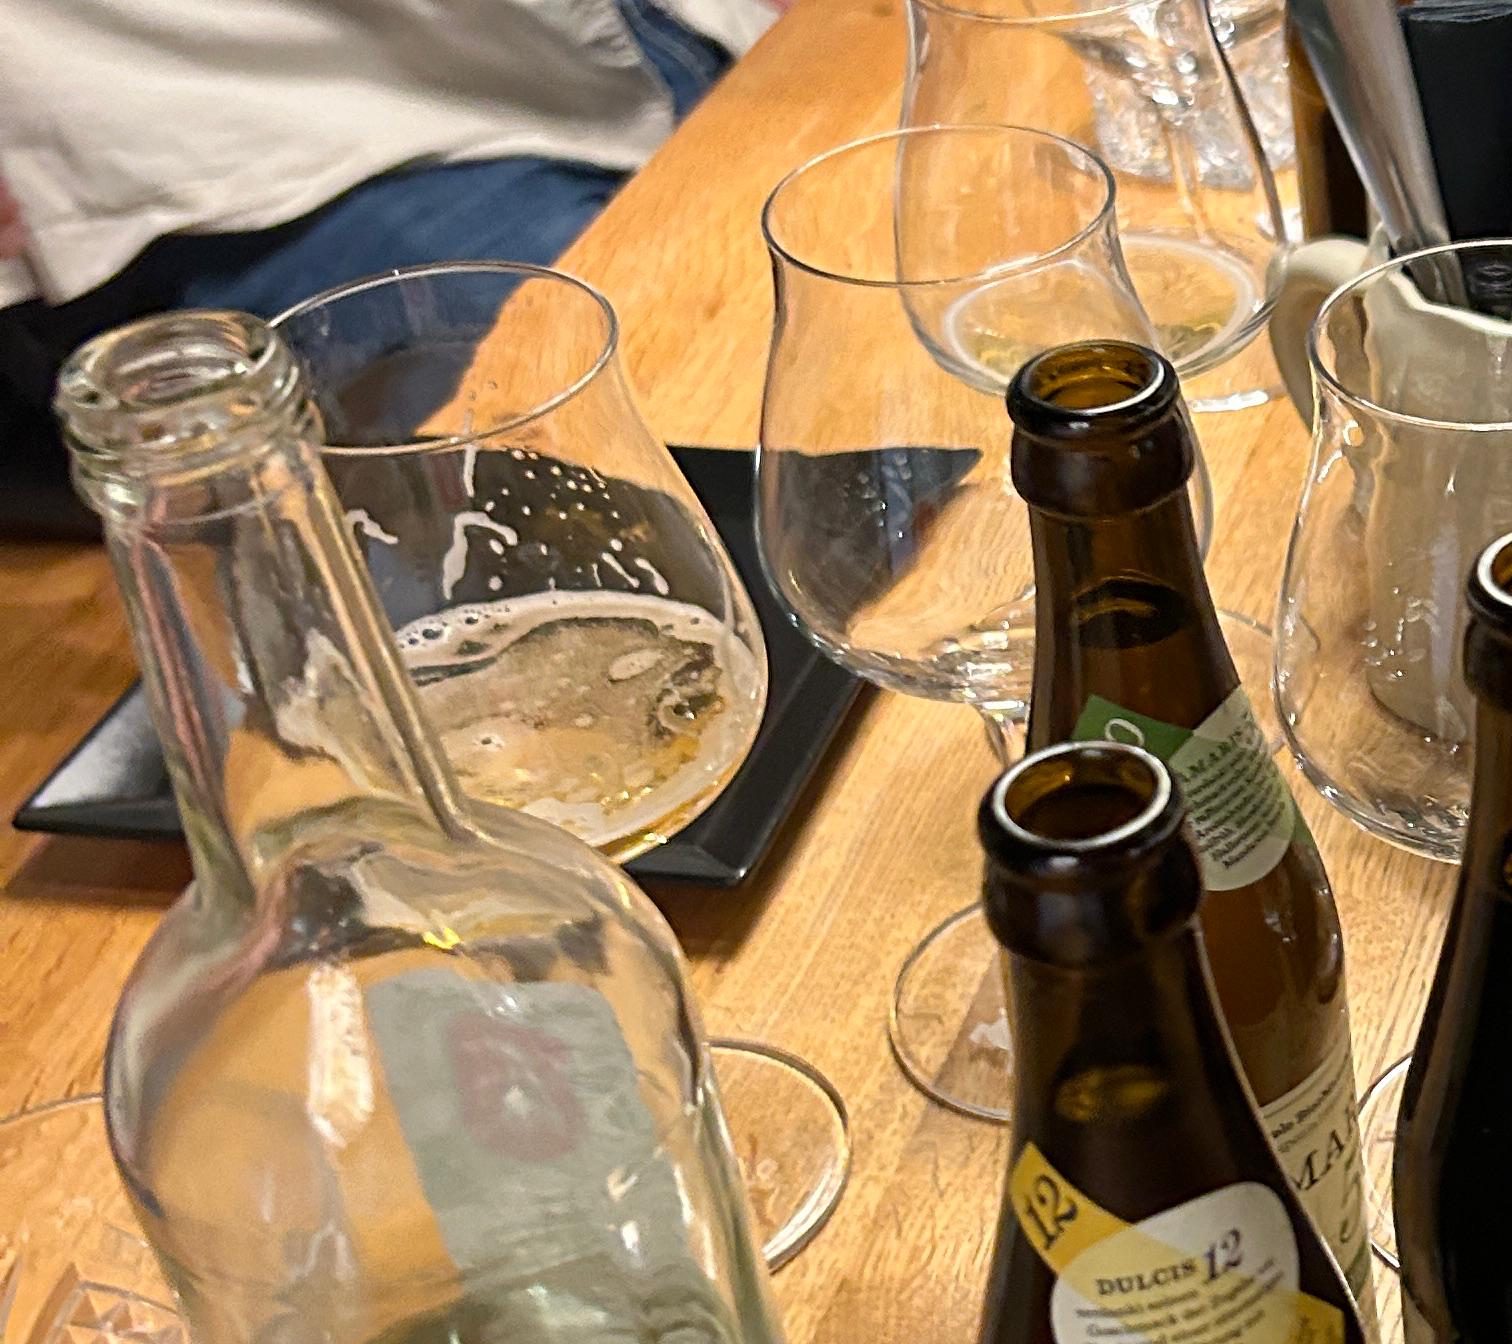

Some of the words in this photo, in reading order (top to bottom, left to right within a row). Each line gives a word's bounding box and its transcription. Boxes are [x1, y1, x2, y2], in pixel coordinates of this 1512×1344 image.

[1023, 1172, 1078, 1251] 12
[1095, 1259, 1197, 1296] DULCIS
[1202, 1229, 1243, 1285] 12
